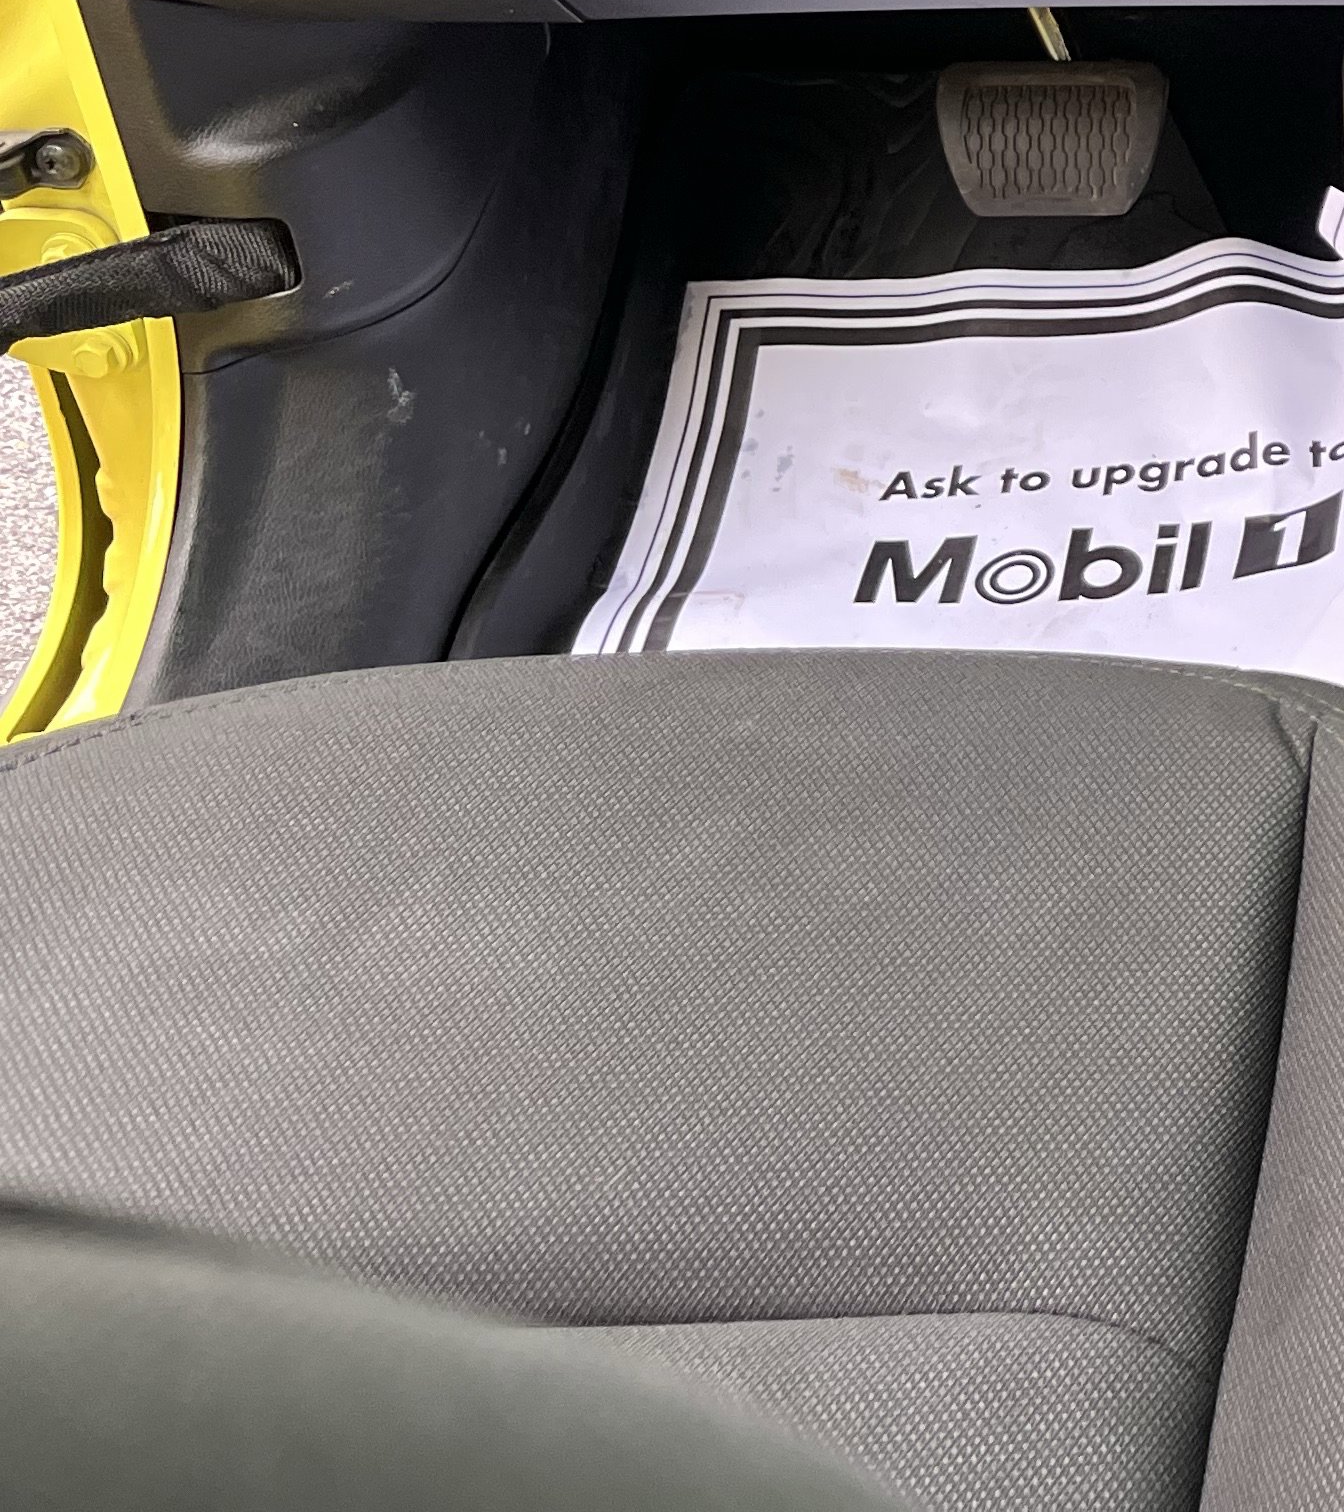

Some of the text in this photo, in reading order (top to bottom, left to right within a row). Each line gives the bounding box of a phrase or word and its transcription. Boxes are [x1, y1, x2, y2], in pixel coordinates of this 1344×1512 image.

[879, 464, 981, 501] Ask
[1000, 467, 1051, 494] to
[1071, 431, 1292, 496] upgrade
[853, 520, 1214, 606] Mobil
